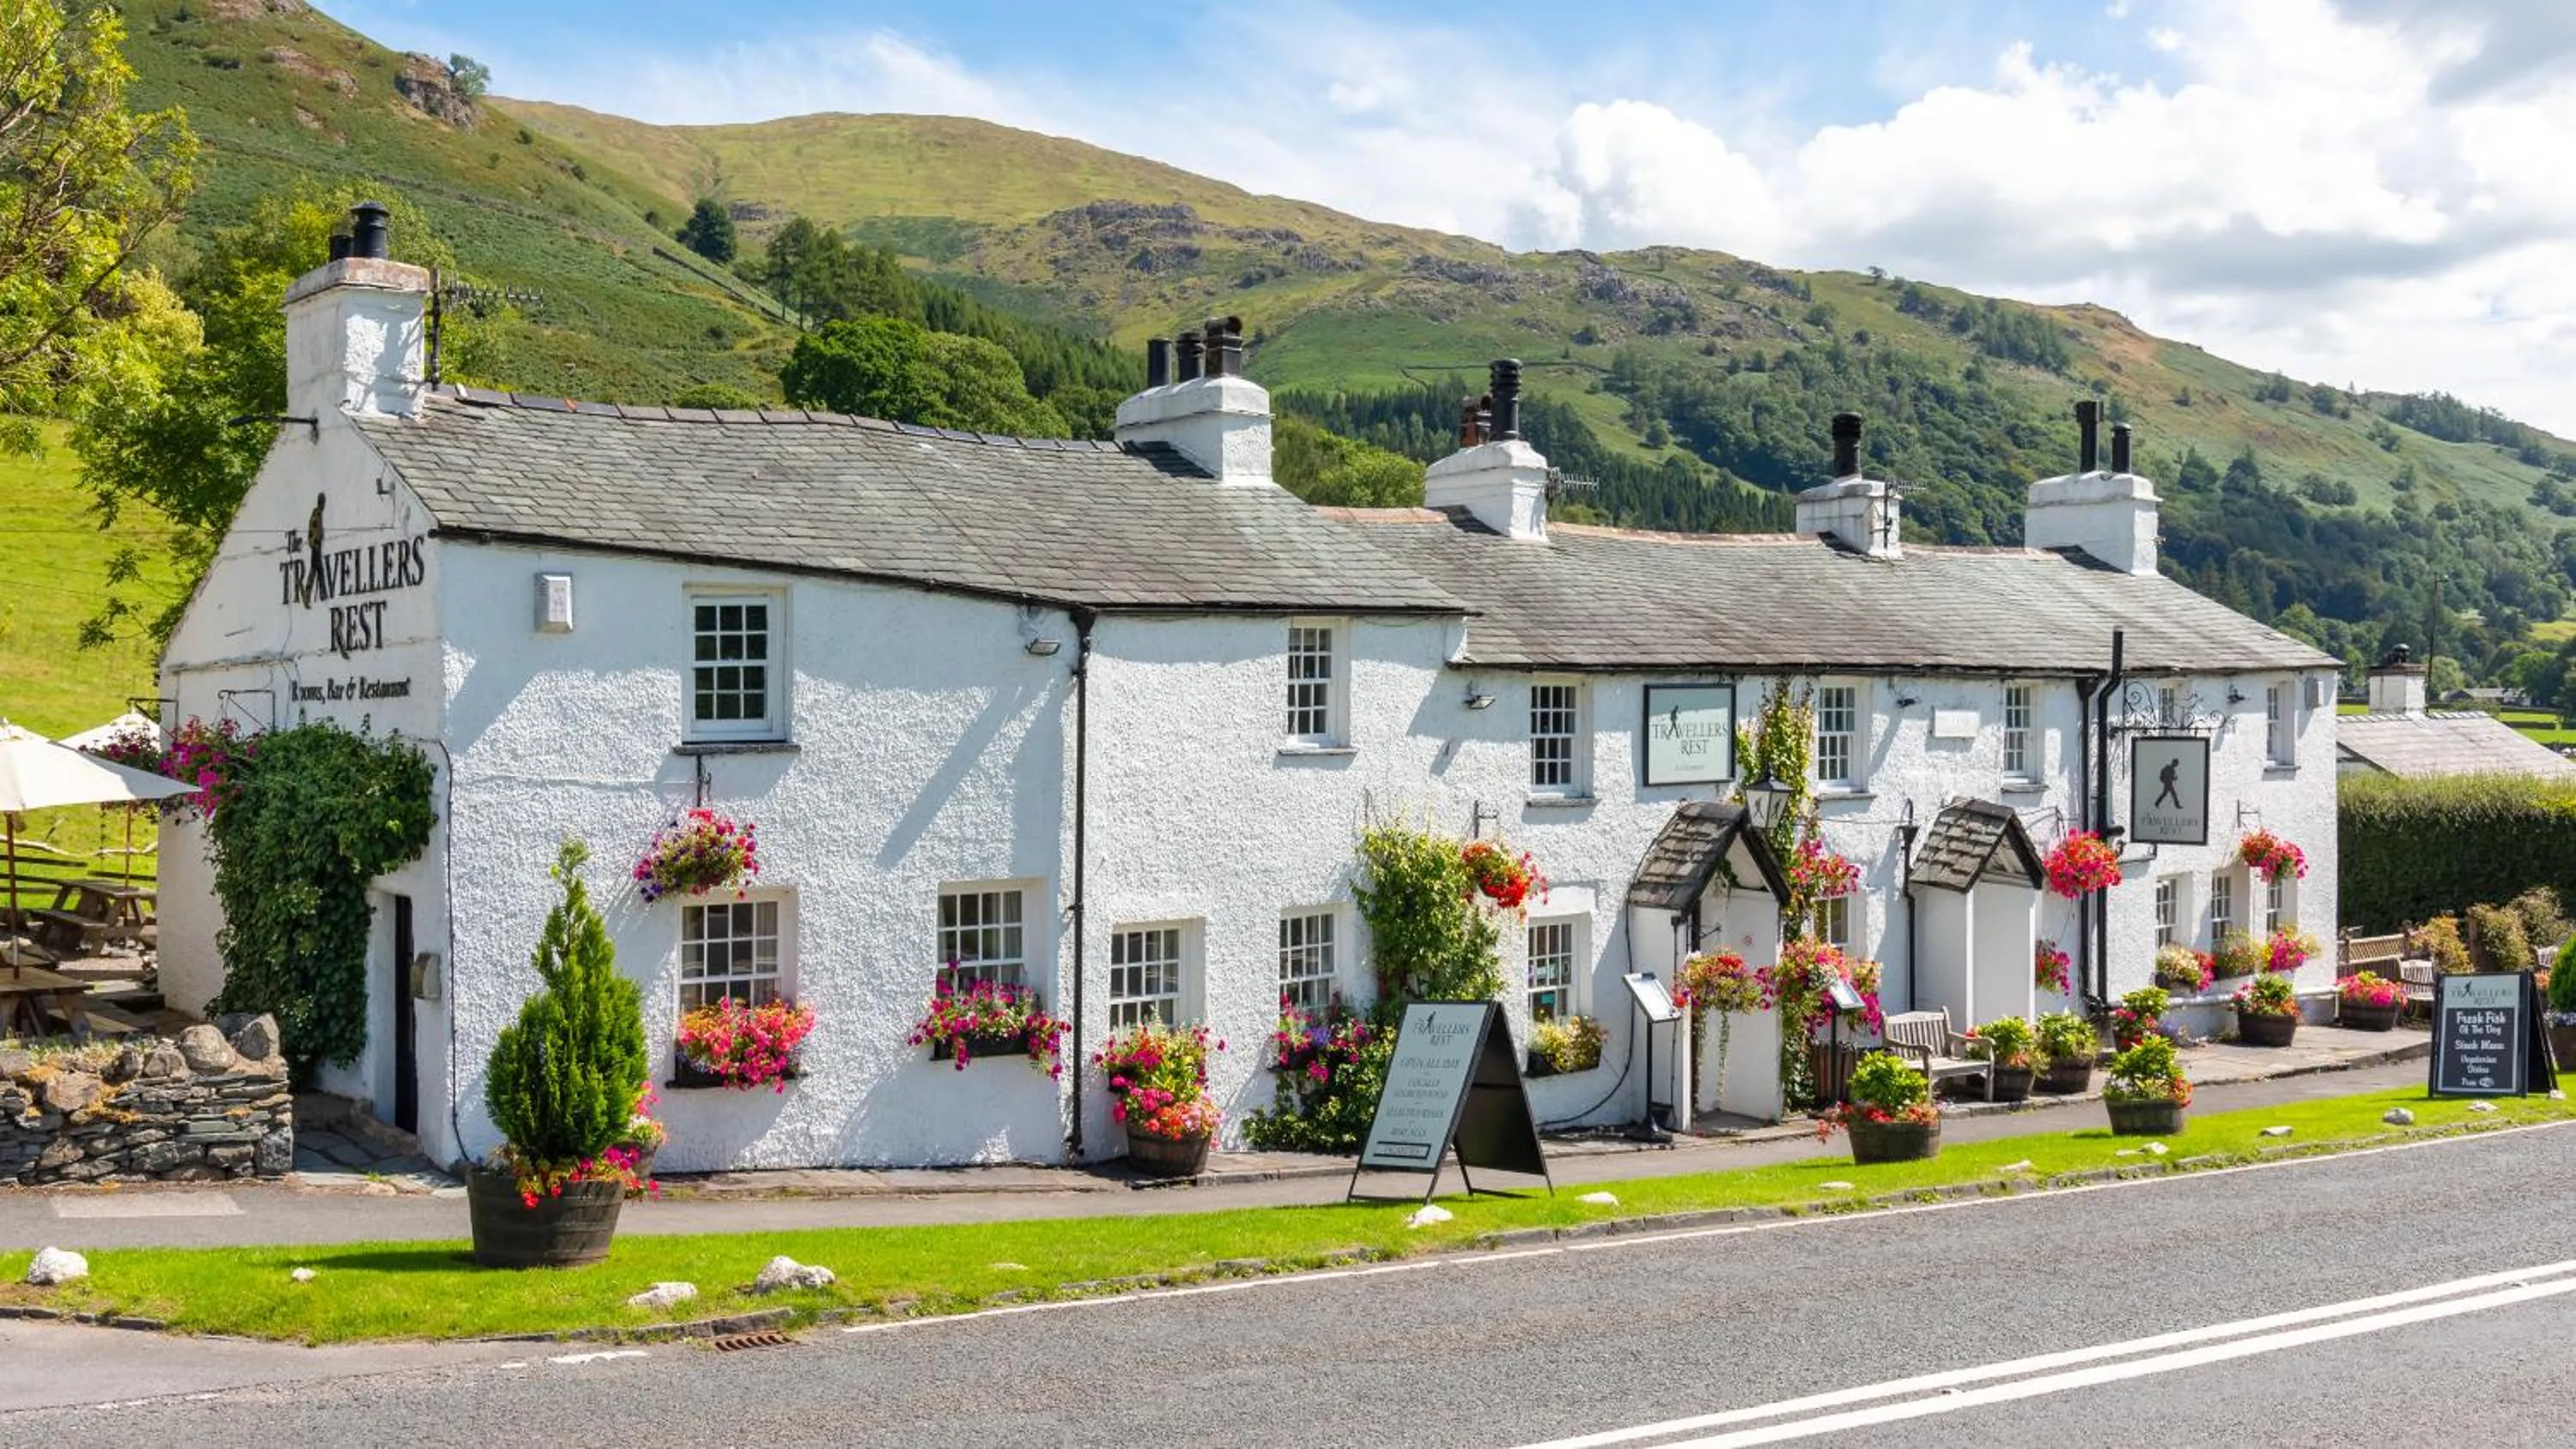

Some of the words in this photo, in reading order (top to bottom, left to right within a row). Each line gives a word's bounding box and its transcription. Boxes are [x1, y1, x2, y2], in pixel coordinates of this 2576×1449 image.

[285, 528, 302, 555] The
[279, 535, 426, 609] TRAVELLERS
[330, 599, 387, 659] REST
[327, 677, 344, 700] Bar
[345, 676, 356, 700] &
[1649, 722, 1728, 740] TRAVELLERS
[1679, 739, 1709, 756] REST
[2486, 1011, 2506, 1024] Fish
